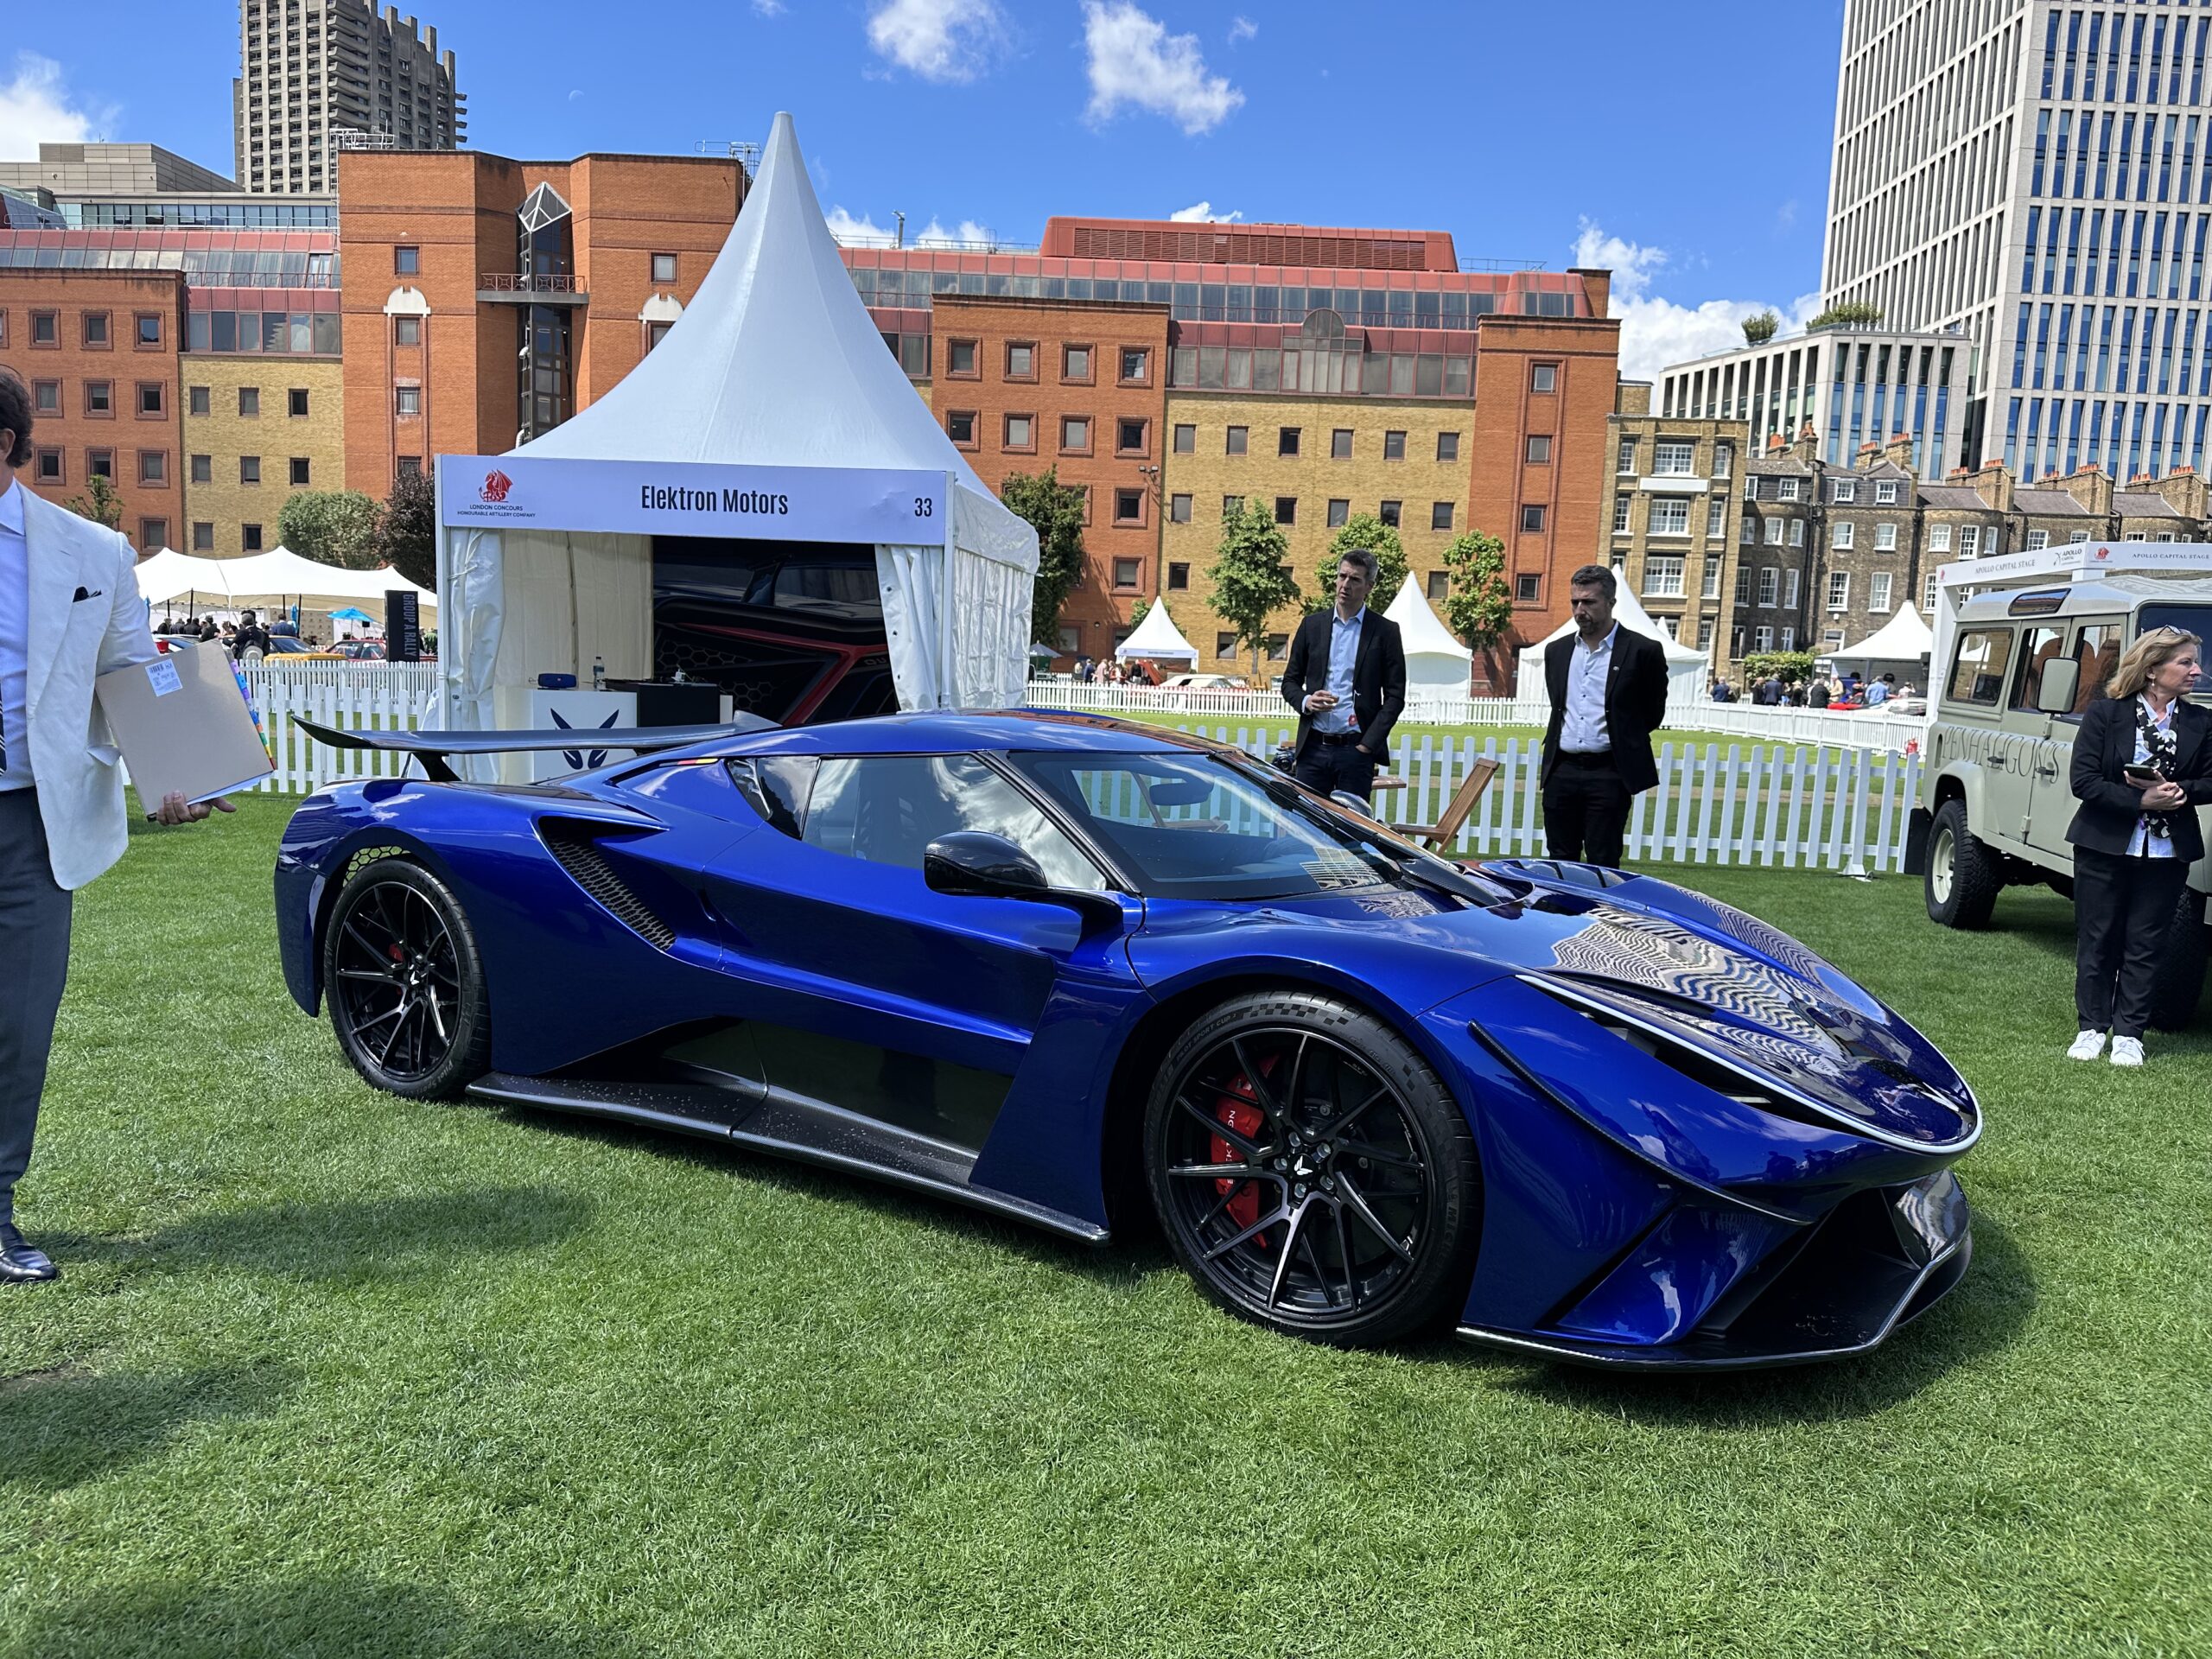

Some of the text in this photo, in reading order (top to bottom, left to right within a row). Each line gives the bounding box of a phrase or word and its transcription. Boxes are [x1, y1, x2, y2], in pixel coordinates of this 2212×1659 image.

[641, 485, 789, 515] Elektron Motors
[914, 497, 932, 517] 33
[2061, 548, 2082, 557] APOLLO
[1994, 563, 2018, 571] CAPITAL
[2018, 559, 2036, 569] STAGE
[403, 594, 416, 623] GROUP
[404, 632, 417, 657] RALLY
